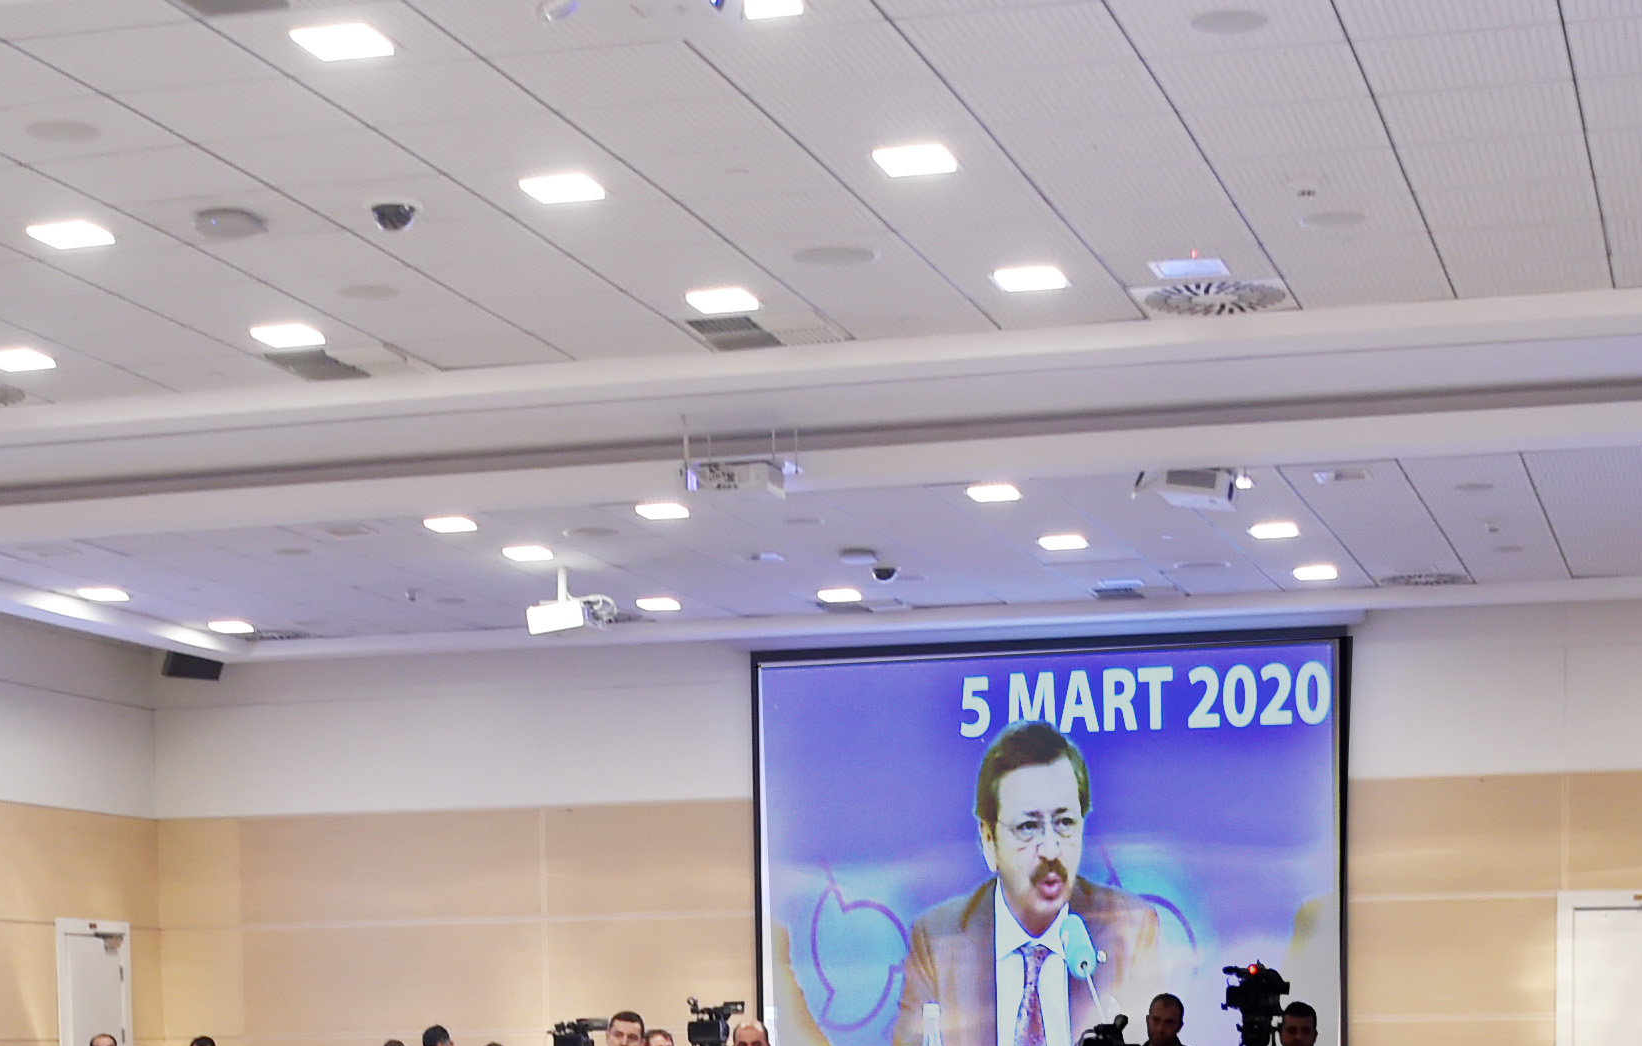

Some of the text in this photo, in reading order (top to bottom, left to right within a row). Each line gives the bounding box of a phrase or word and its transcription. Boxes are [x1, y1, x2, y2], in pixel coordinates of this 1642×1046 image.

[959, 661, 1331, 737] 5 MART 2020
